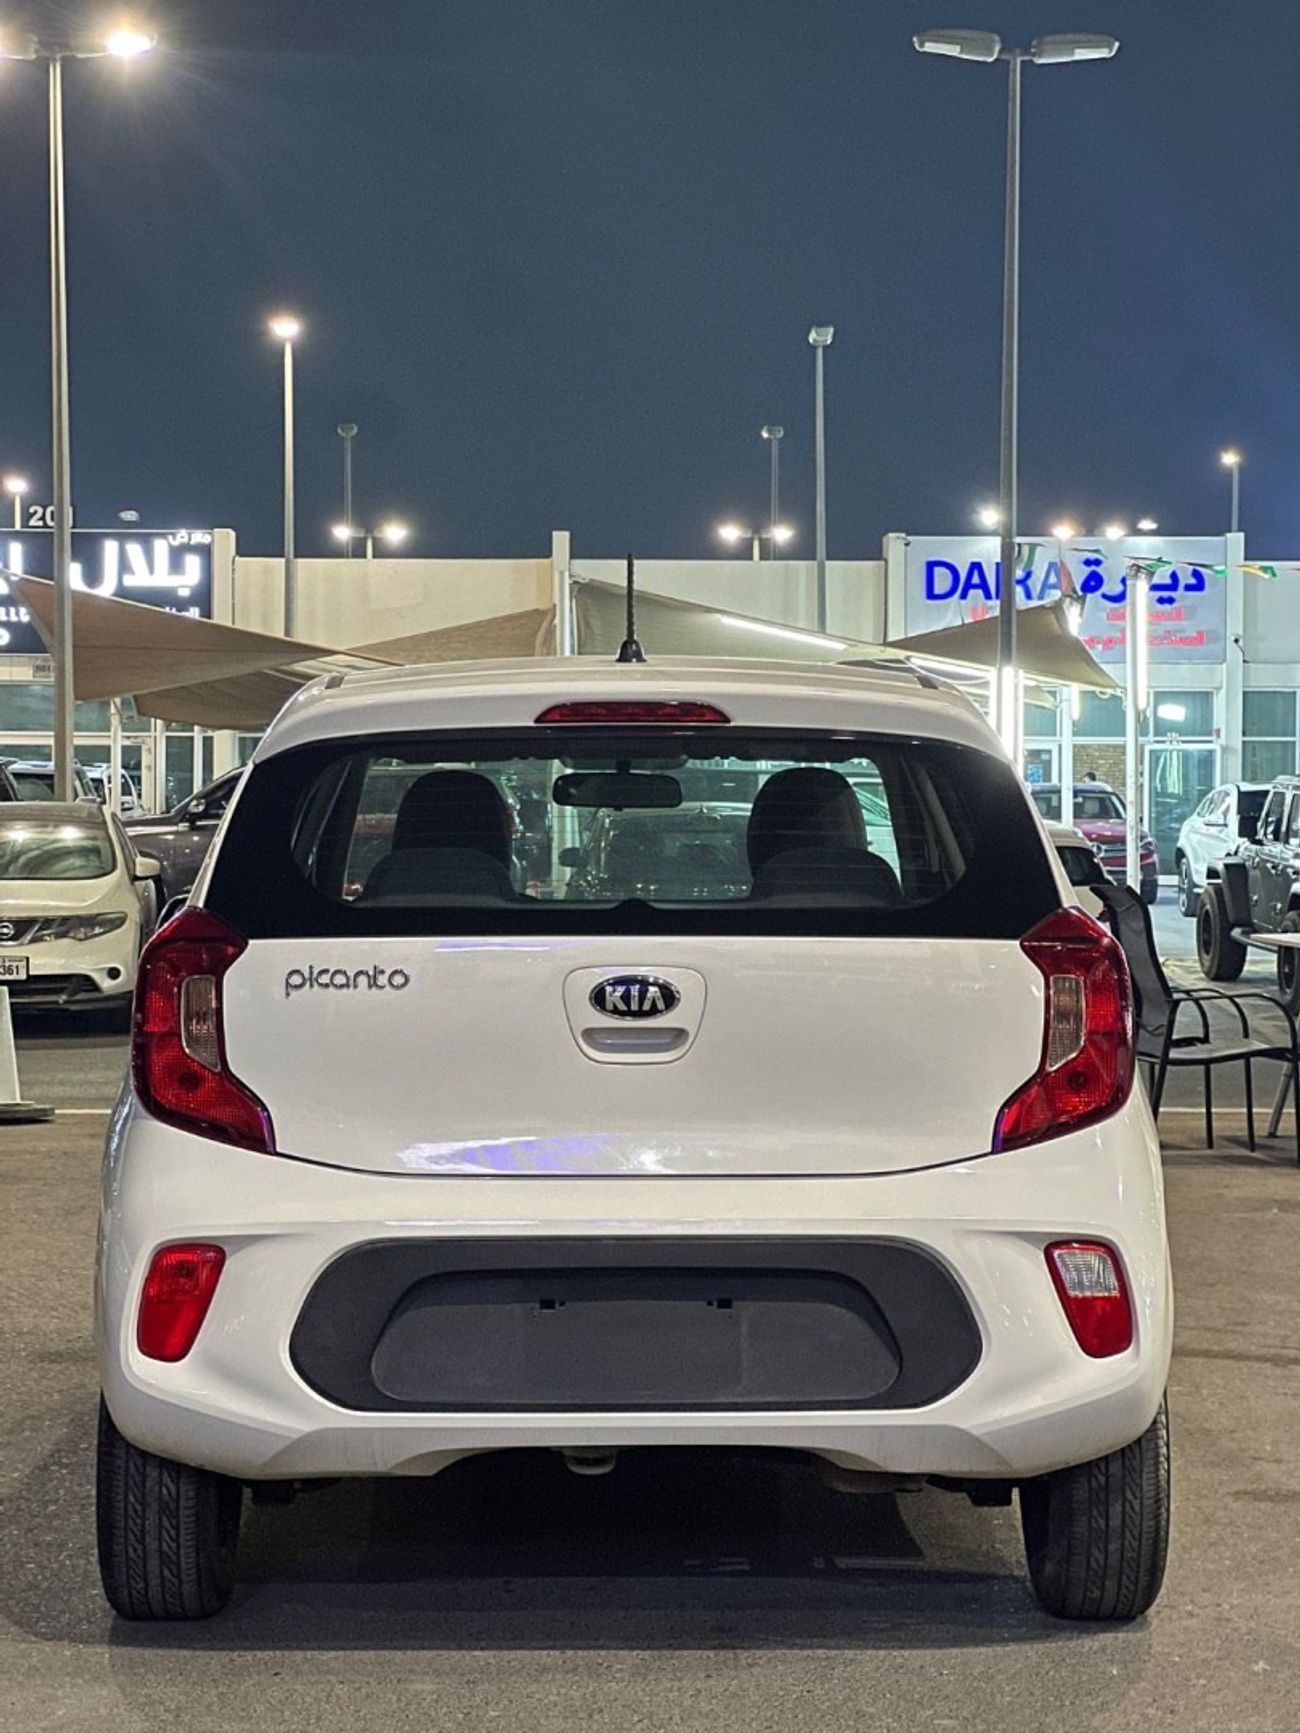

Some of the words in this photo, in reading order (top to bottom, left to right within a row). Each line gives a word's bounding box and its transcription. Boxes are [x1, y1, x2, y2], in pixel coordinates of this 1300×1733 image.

[69, 538, 201, 597] بلال
[284, 964, 410, 999] picanto
[604, 984, 666, 1011] KIA
